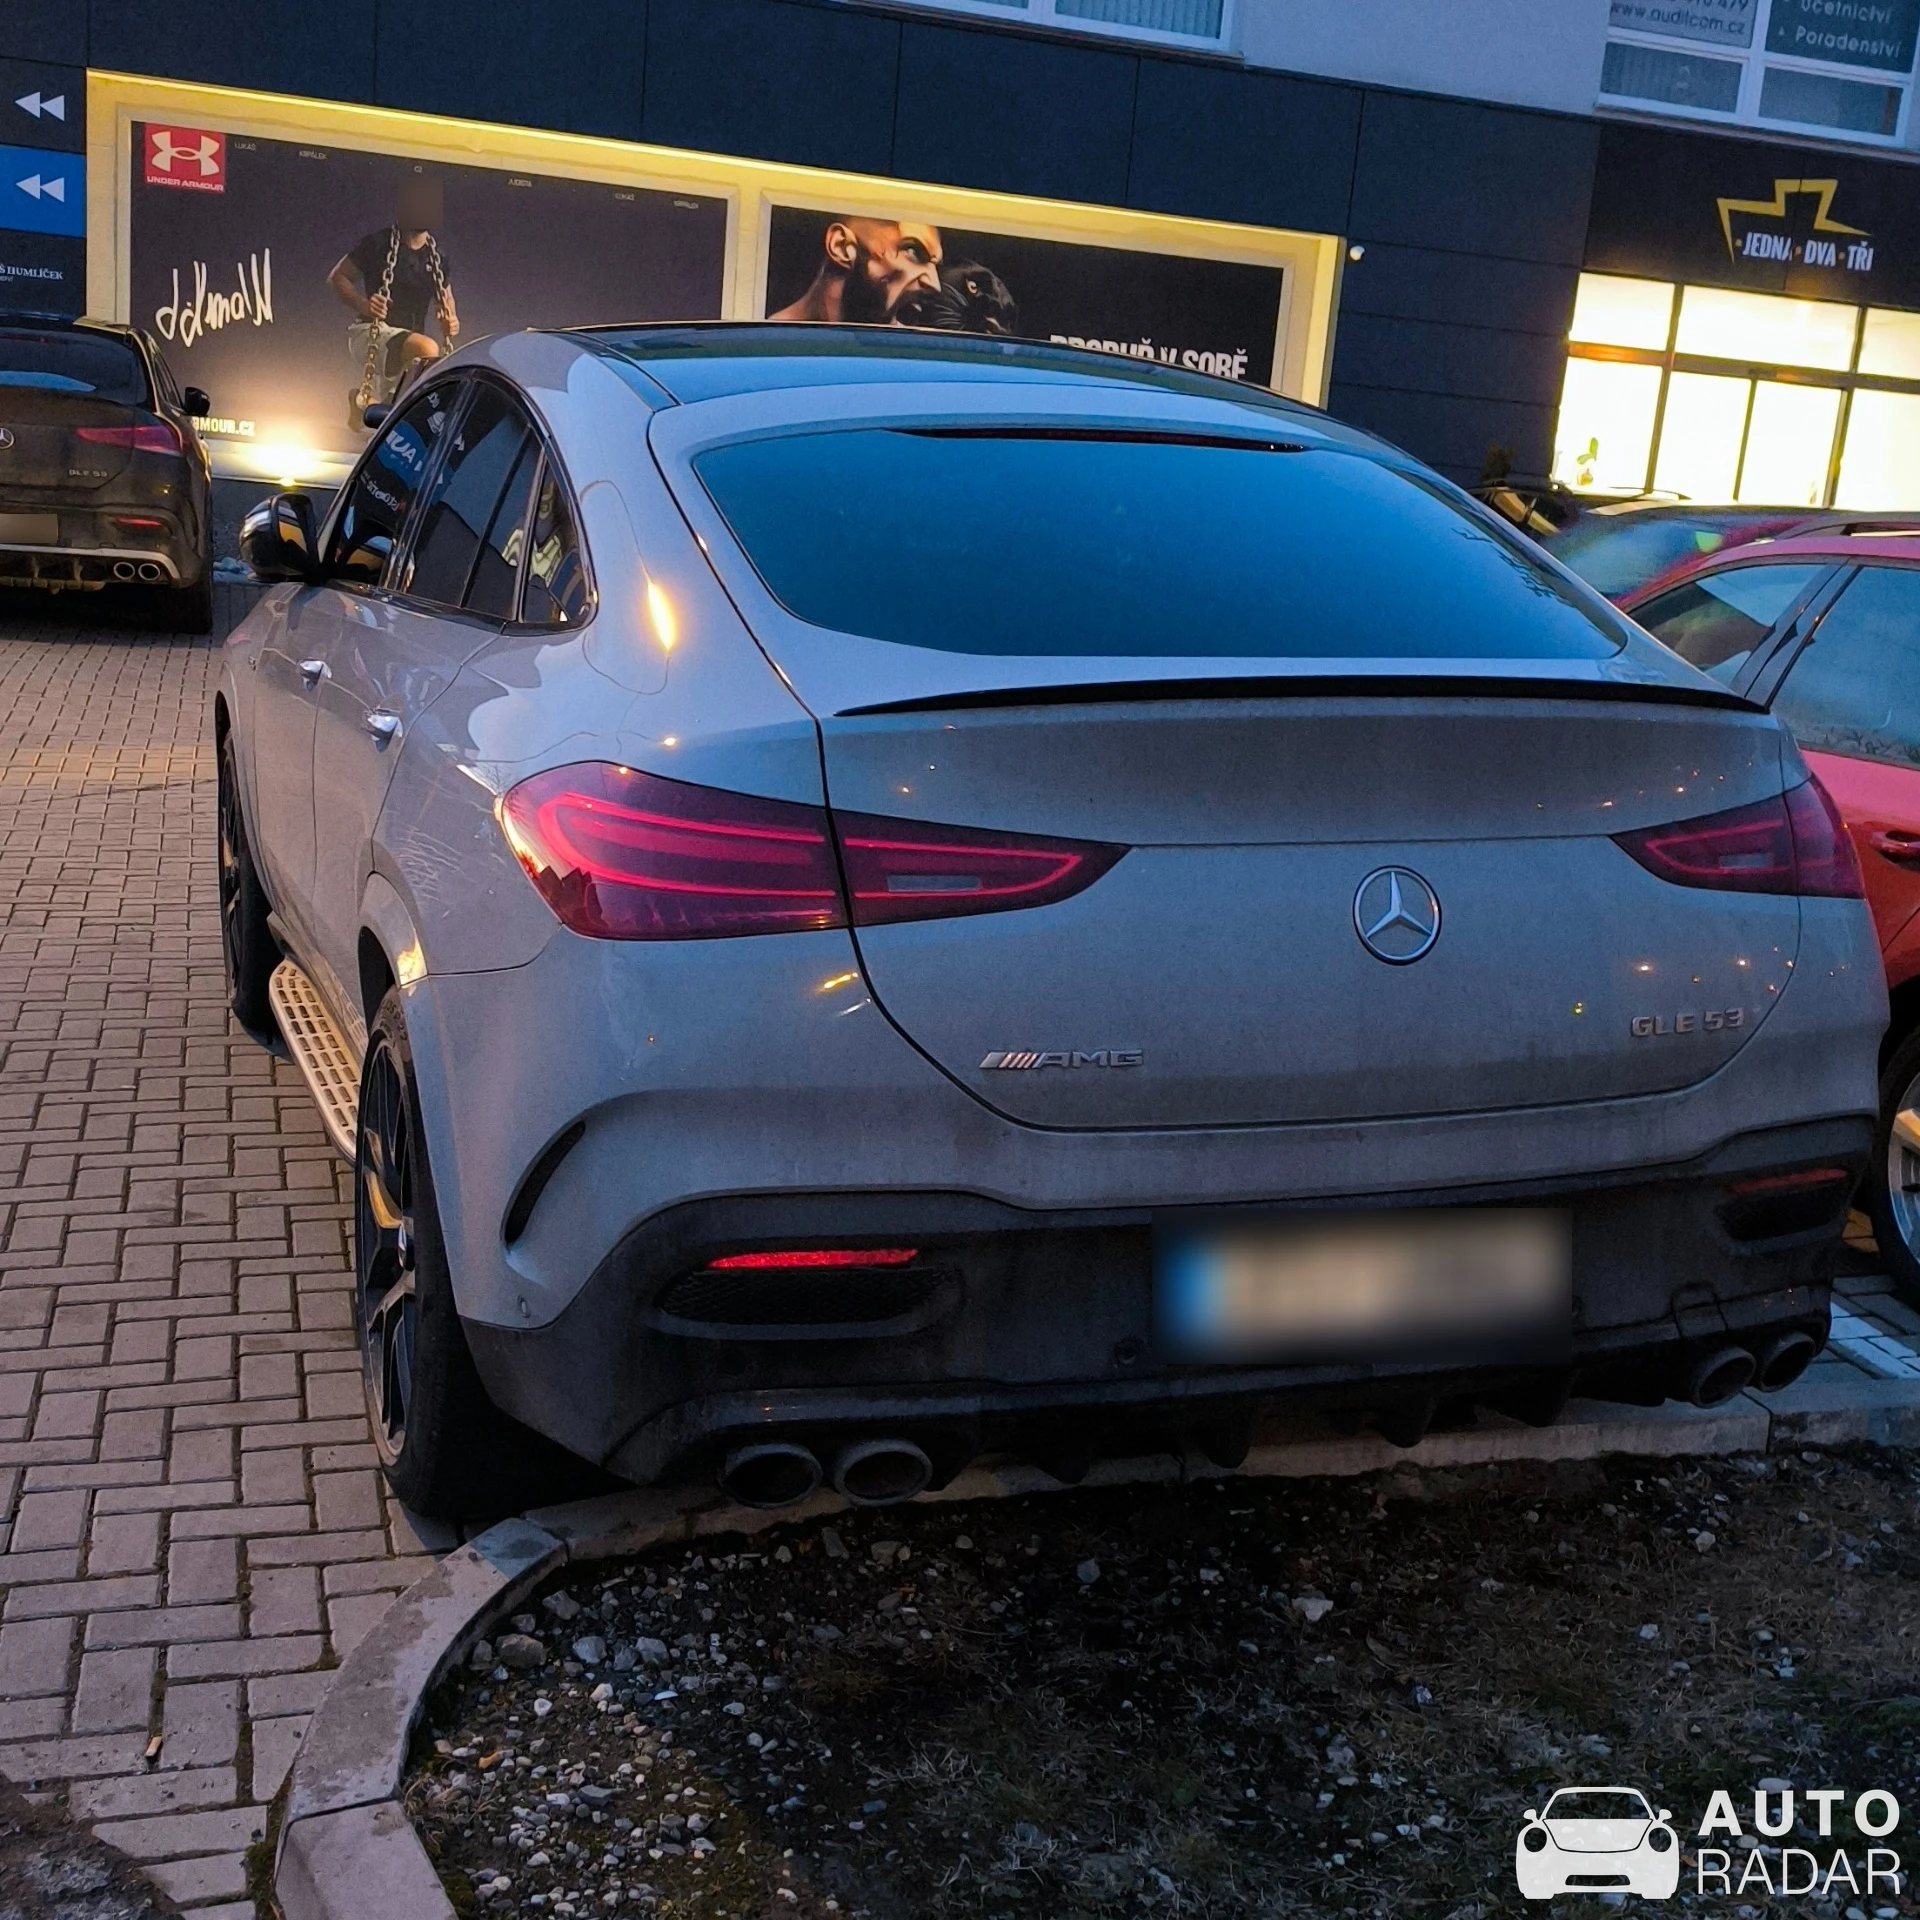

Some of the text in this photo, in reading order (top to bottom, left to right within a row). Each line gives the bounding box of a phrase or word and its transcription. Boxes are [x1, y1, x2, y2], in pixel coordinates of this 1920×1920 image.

[146, 175, 224, 192] UNDER ARMOUR
[1742, 231, 1874, 271] JEDNA DVA TŘI
[1631, 1006, 1745, 1037] GLE 53
[1031, 1049, 1144, 1069] AMG
